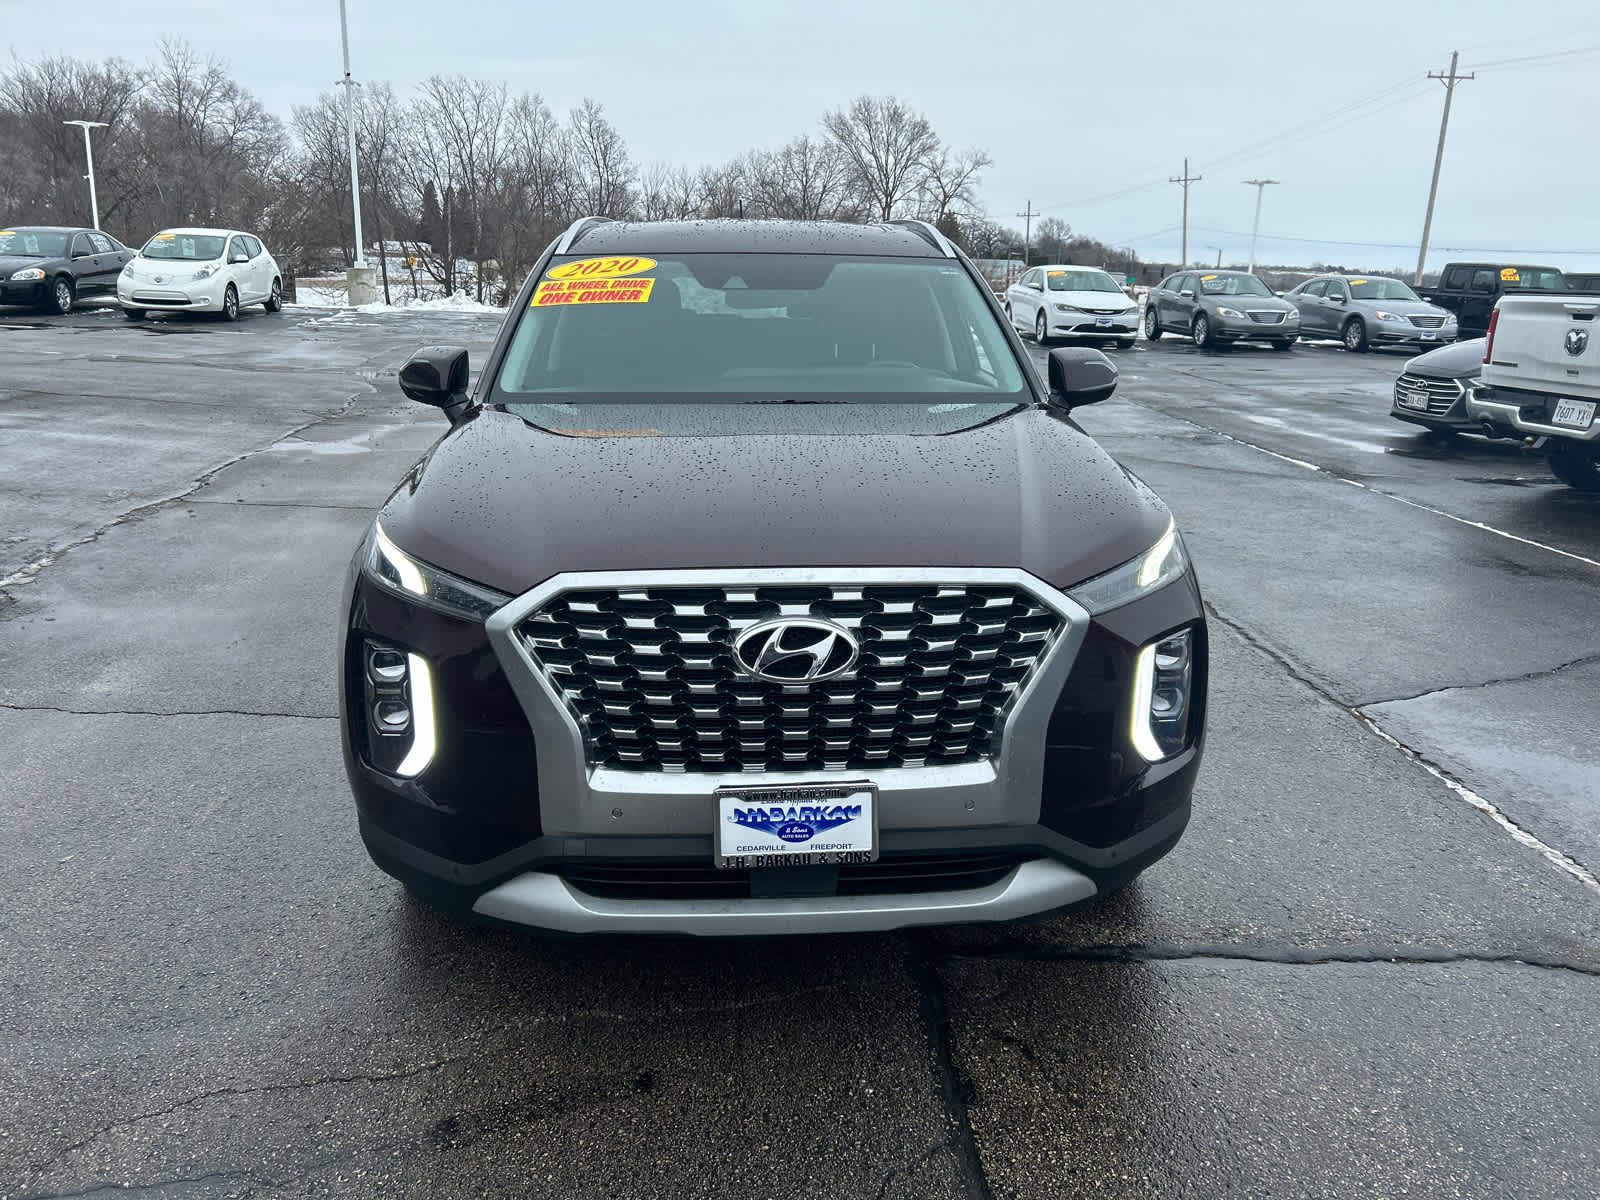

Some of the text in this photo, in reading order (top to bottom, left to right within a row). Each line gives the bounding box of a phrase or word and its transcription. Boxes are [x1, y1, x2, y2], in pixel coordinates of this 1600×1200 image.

[562, 259, 639, 277] 2020
[540, 279, 651, 292] ALL WHEEL DRIVE
[539, 290, 642, 304] ONE OWNER
[757, 854, 811, 867] BARKAU
[818, 853, 829, 865] &
[836, 850, 871, 864] SONS
